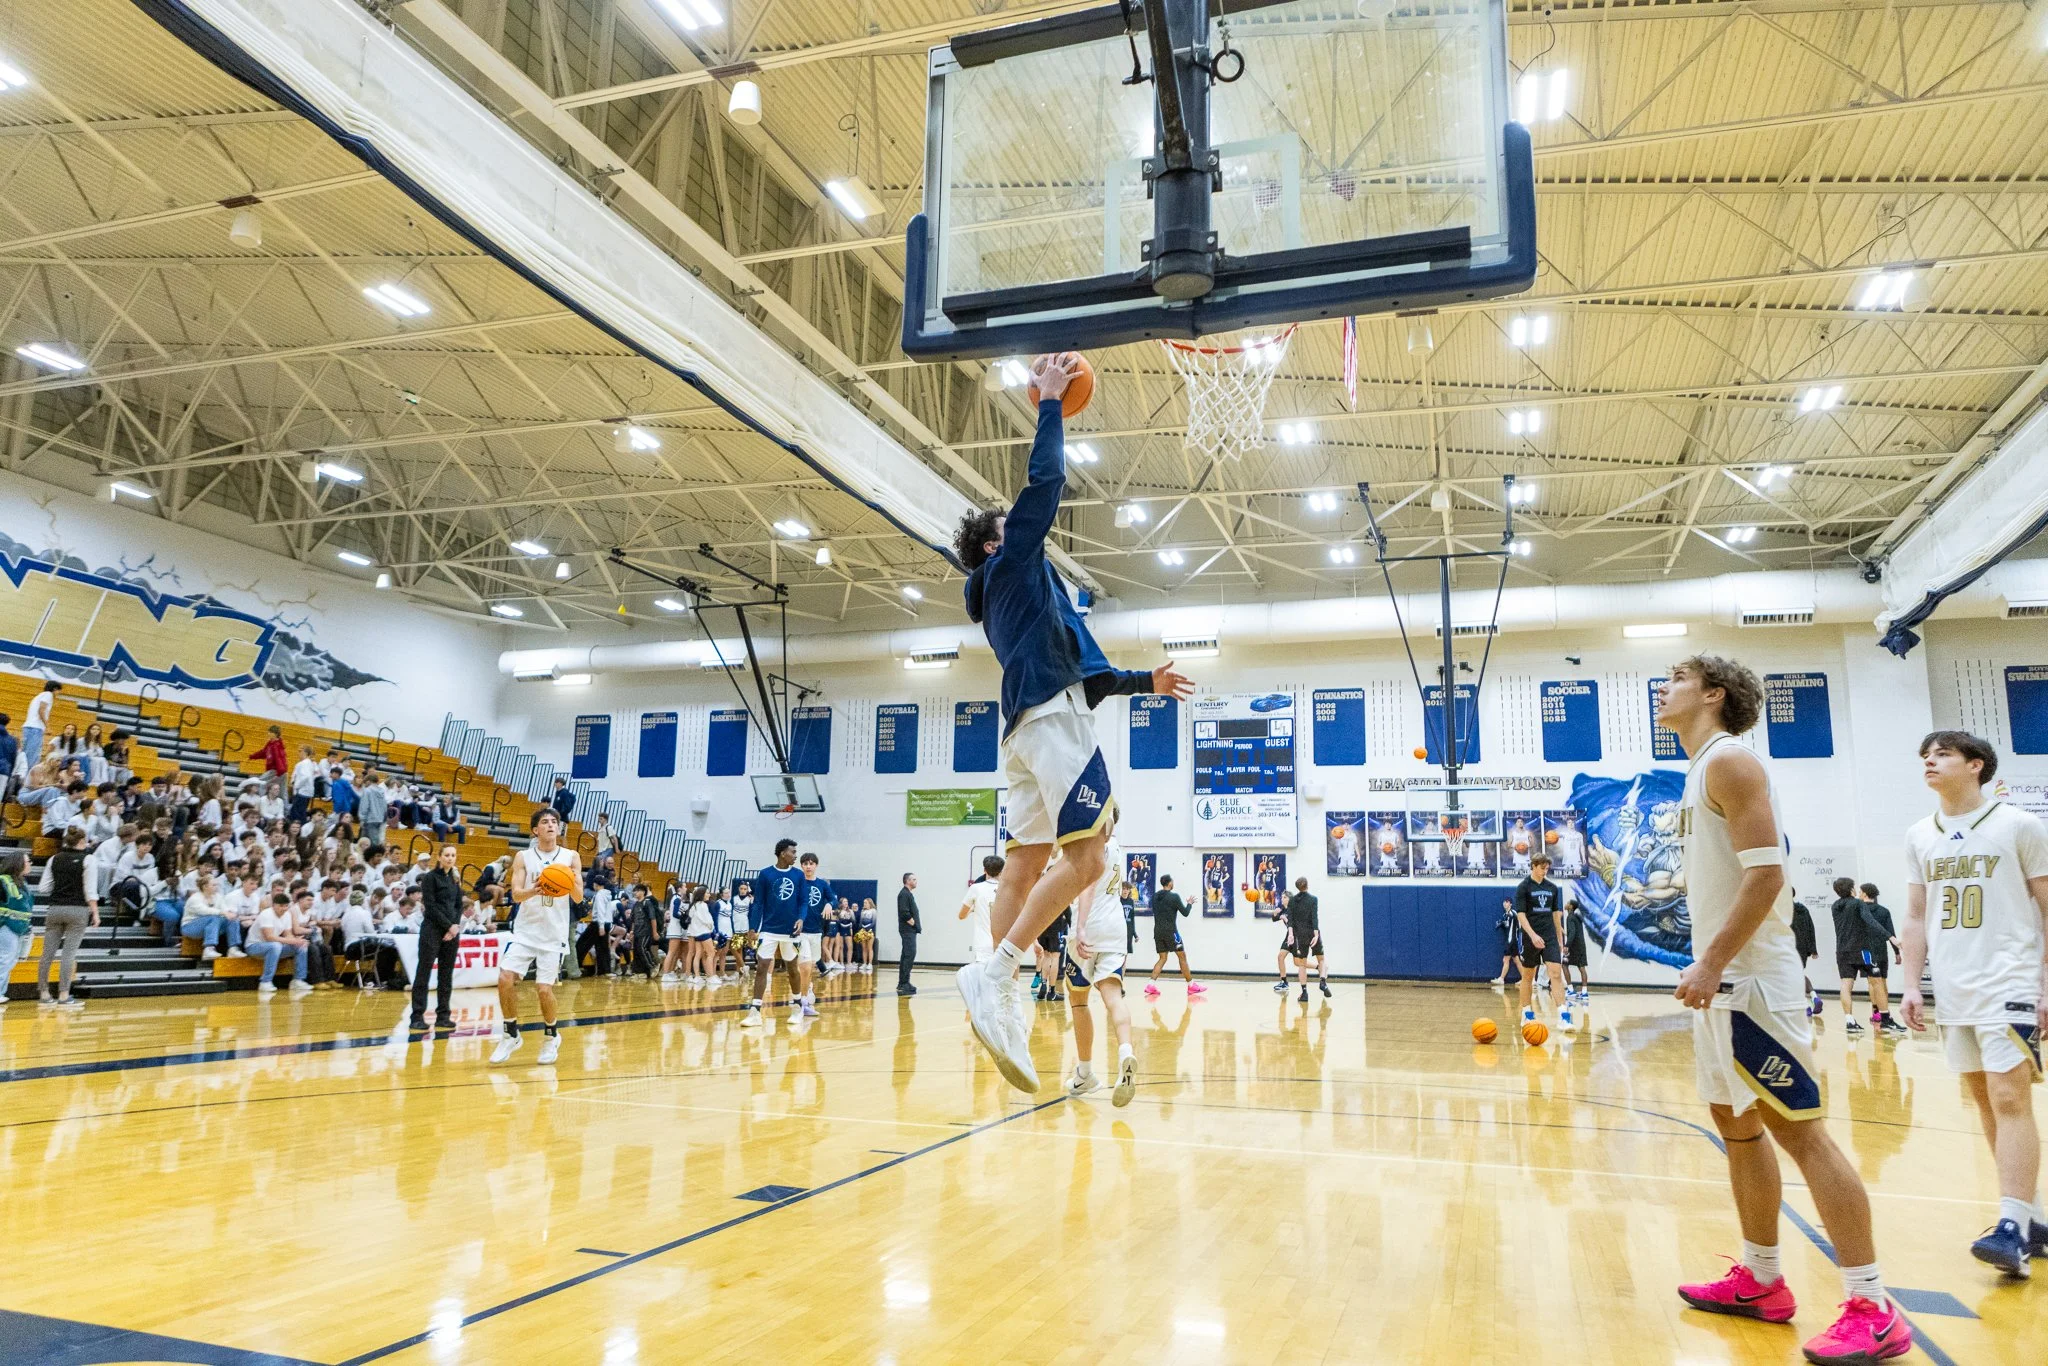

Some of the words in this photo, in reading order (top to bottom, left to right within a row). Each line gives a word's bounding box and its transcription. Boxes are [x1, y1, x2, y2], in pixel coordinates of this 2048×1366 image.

[1766, 679, 1825, 688] SWIMMING
[1547, 686, 1591, 695] SOCCER
[1314, 691, 1363, 700] GYMNASTICS
[1141, 700, 1167, 708] GOLF
[879, 706, 917, 714] FOOTBALL
[964, 706, 990, 714] GOLF
[577, 717, 610, 725] BASEBALL
[1196, 739, 1234, 749] LIGHTNING
[1265, 738, 1290, 747] GUEST
[1220, 798, 1240, 806] BLUE
[1220, 806, 1252, 815] SPRUCE
[1926, 855, 2000, 882] LEGACY
[1941, 885, 1983, 929] 30
